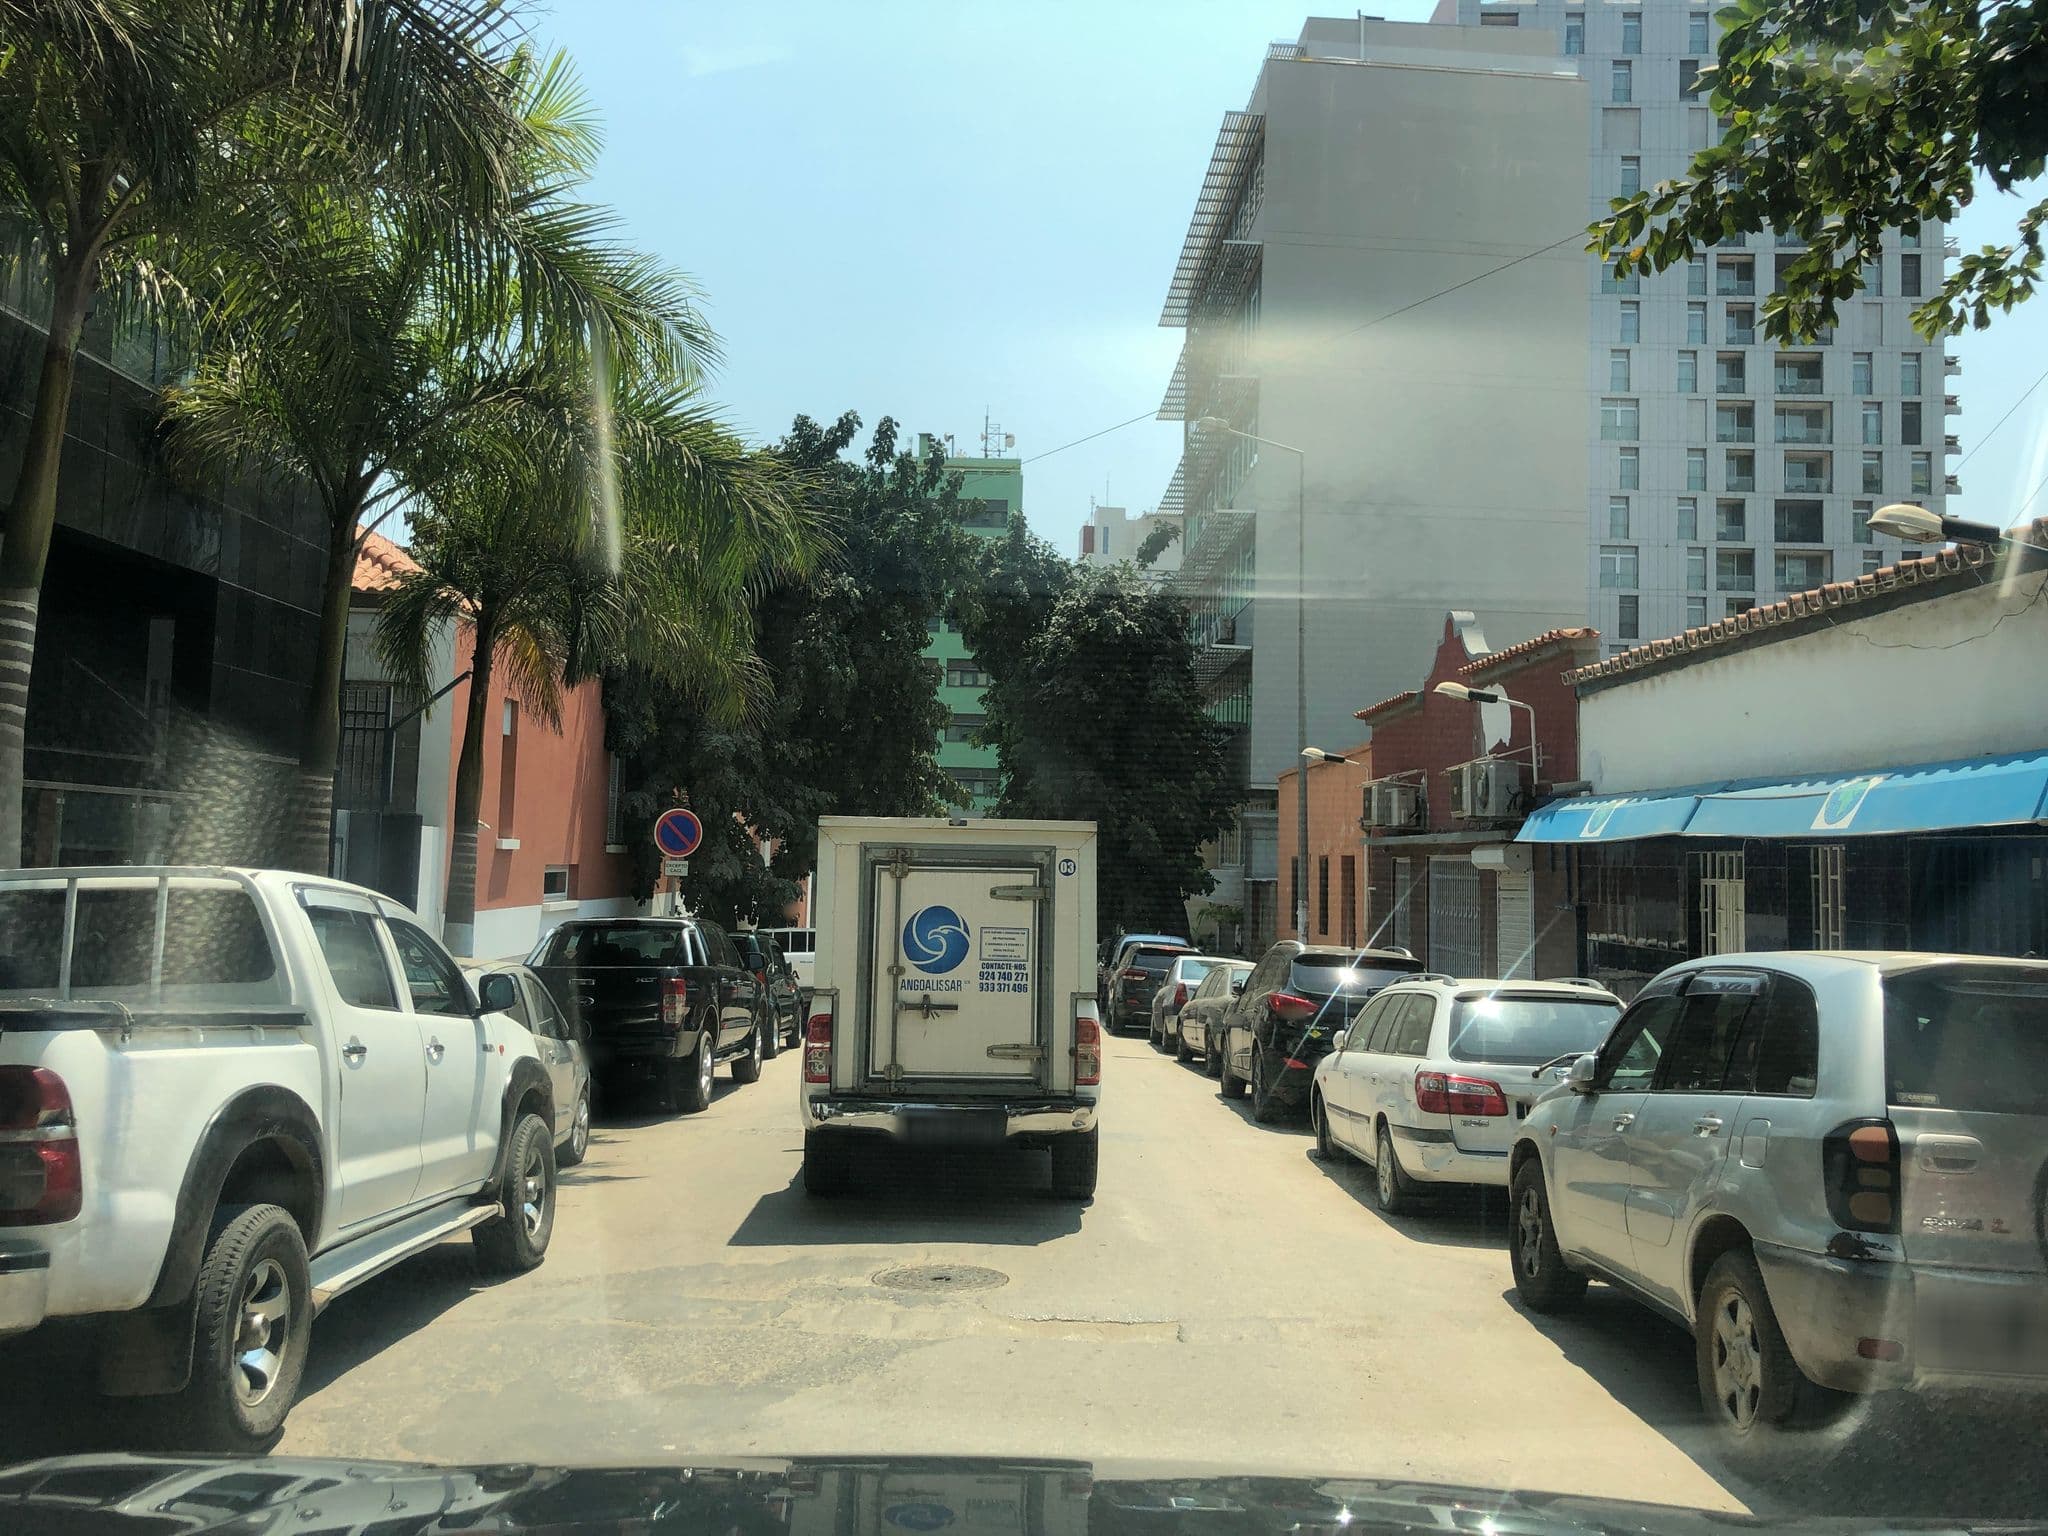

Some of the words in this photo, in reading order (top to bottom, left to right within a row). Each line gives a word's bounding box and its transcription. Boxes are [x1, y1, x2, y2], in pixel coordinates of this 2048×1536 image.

[1060, 861, 1074, 874] 03
[981, 962, 1027, 971] CONTACTE-NOS
[979, 971, 996, 981] 924
[997, 971, 1013, 982] 740
[1014, 972, 1029, 982] 271
[900, 979, 962, 991] ANGOALISSAR
[979, 982, 995, 992] 933
[997, 983, 1011, 993] 371
[1012, 983, 1028, 993] 496
